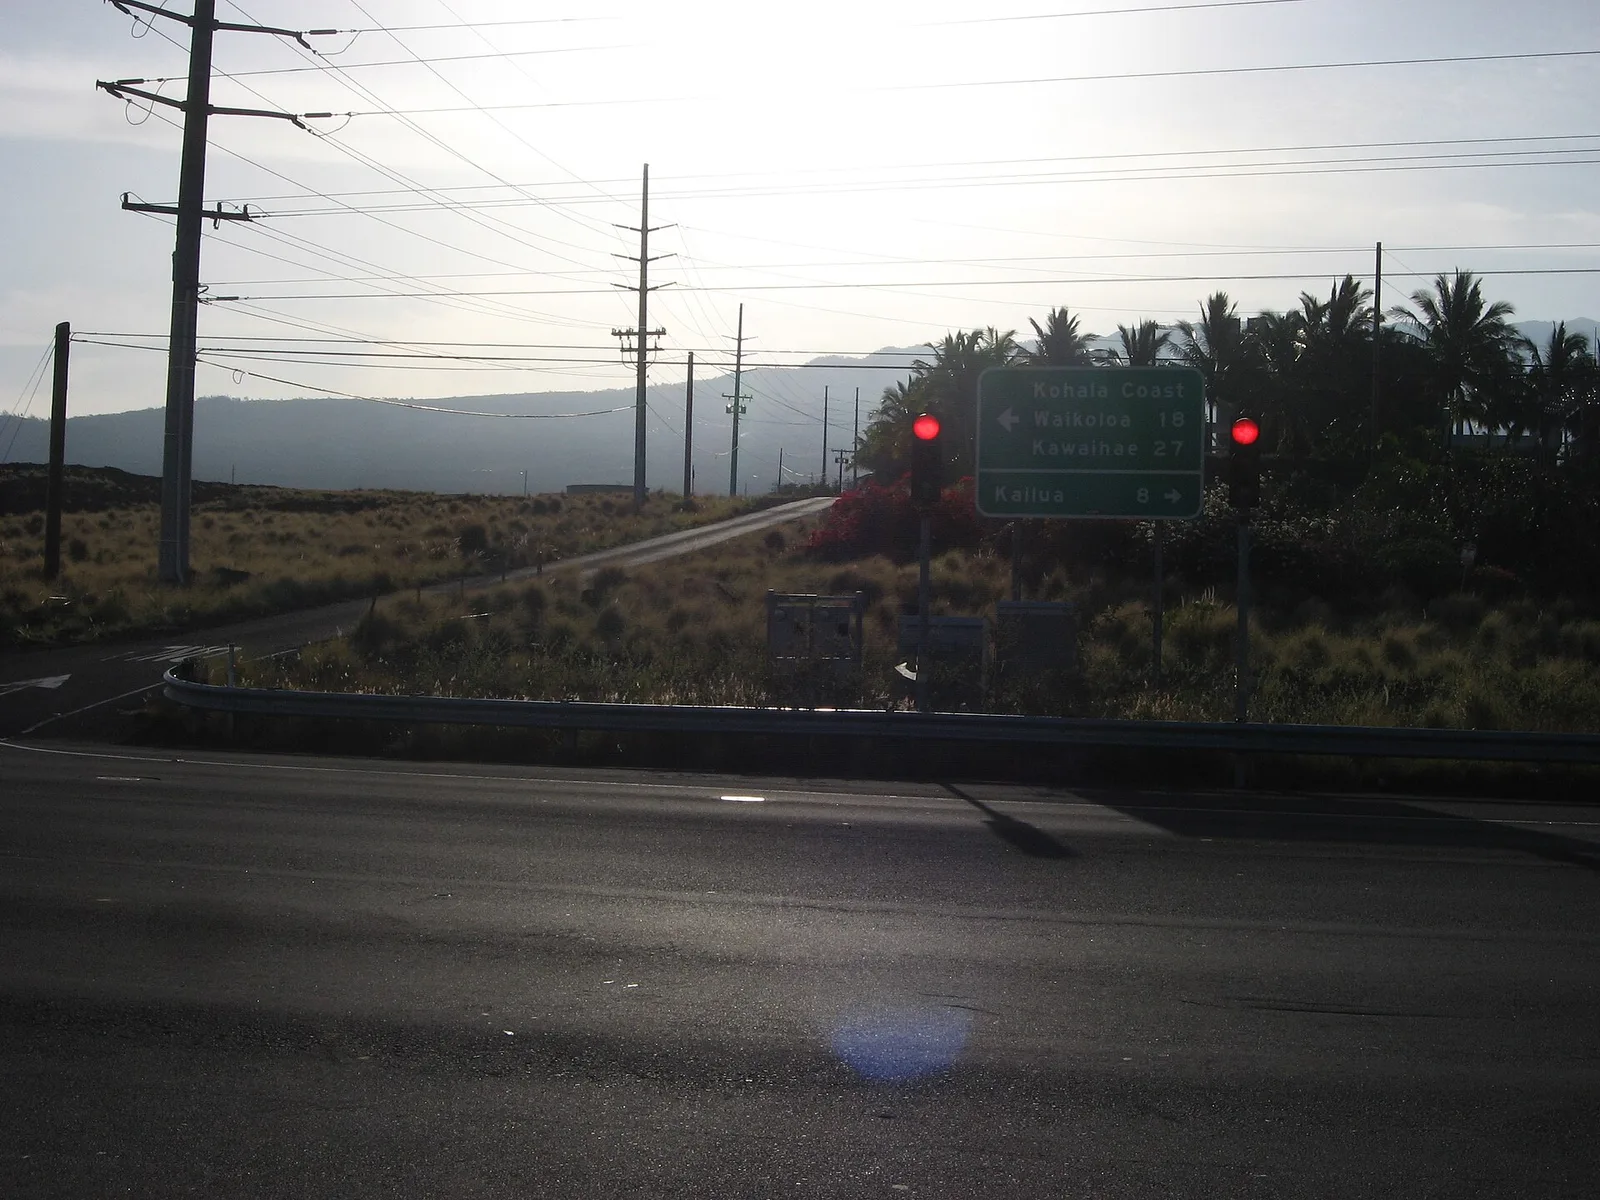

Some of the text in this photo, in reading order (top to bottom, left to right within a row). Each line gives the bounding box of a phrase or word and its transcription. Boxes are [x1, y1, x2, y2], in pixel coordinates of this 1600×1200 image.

[1033, 383, 1185, 399] Kohala Coast
[1034, 411, 1185, 428] Waikoloa 18
[1032, 440, 1184, 457] Kawaihae 27
[995, 486, 1150, 504] Kailua 8
